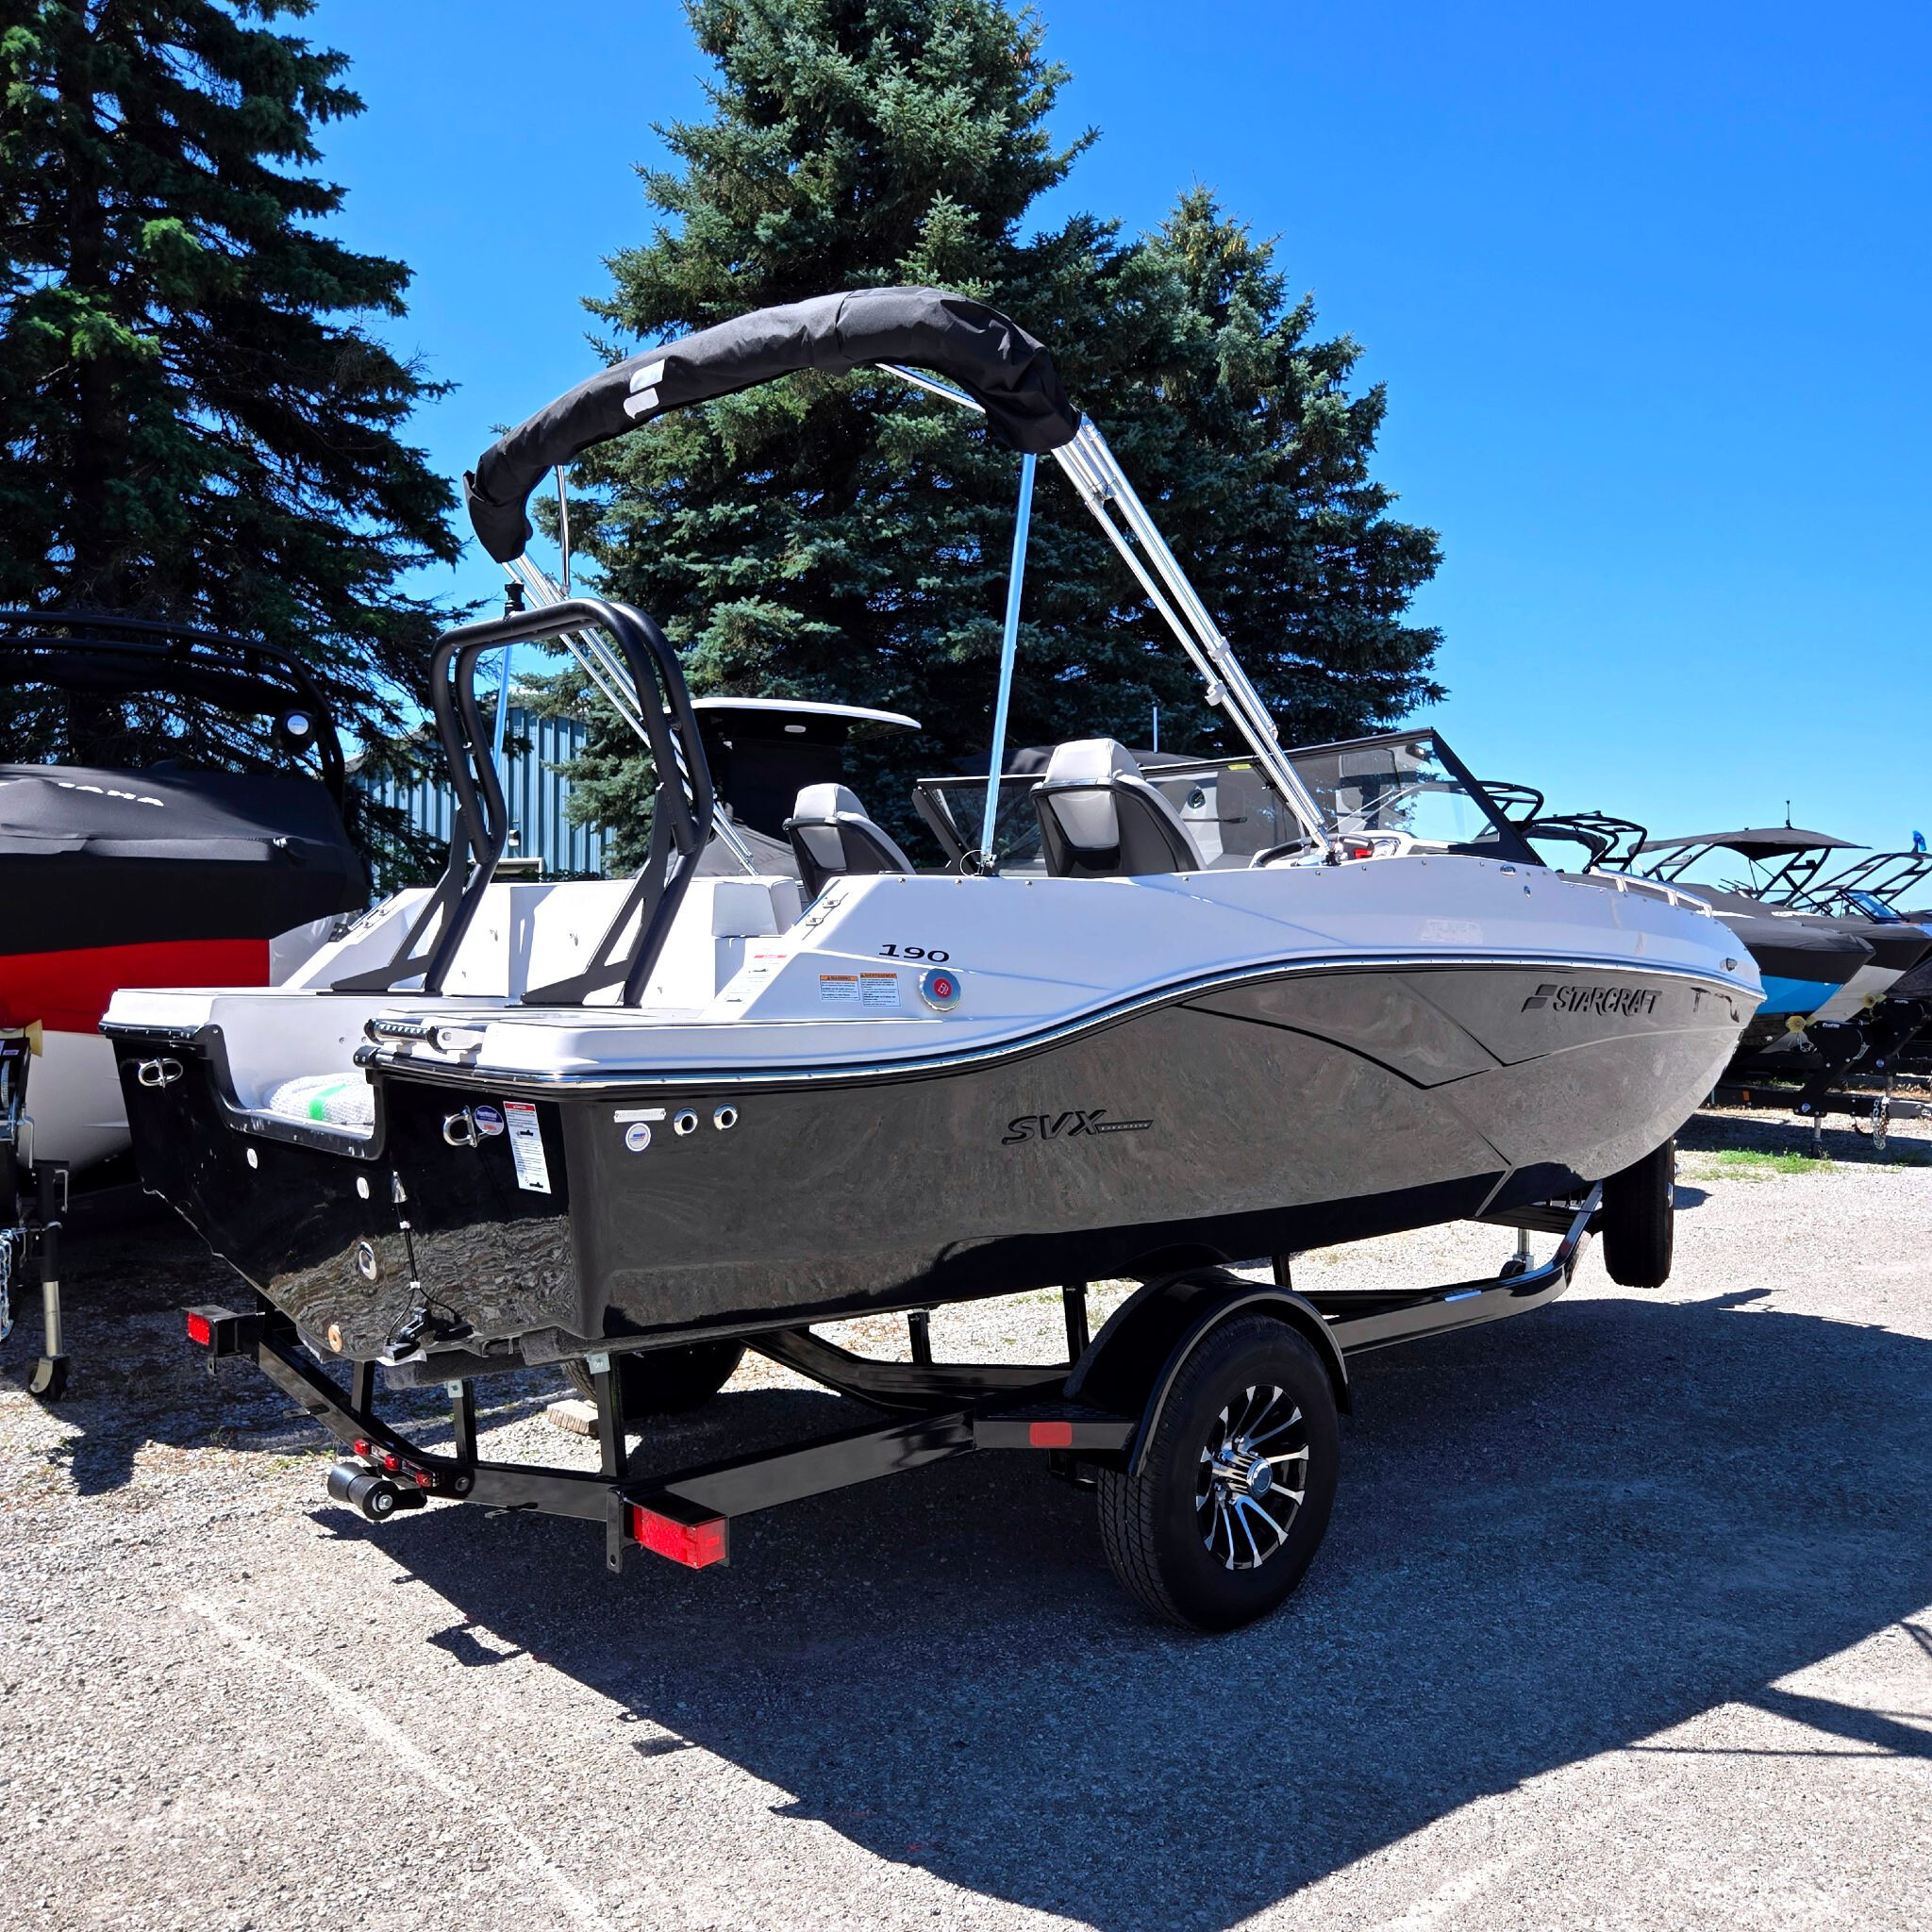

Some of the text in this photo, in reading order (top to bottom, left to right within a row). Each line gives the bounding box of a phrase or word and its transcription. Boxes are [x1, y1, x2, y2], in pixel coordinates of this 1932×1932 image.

[878, 943, 950, 962] 190
[1553, 986, 1662, 1016] STARCRAFT
[1001, 1109, 1108, 1145] SVX
